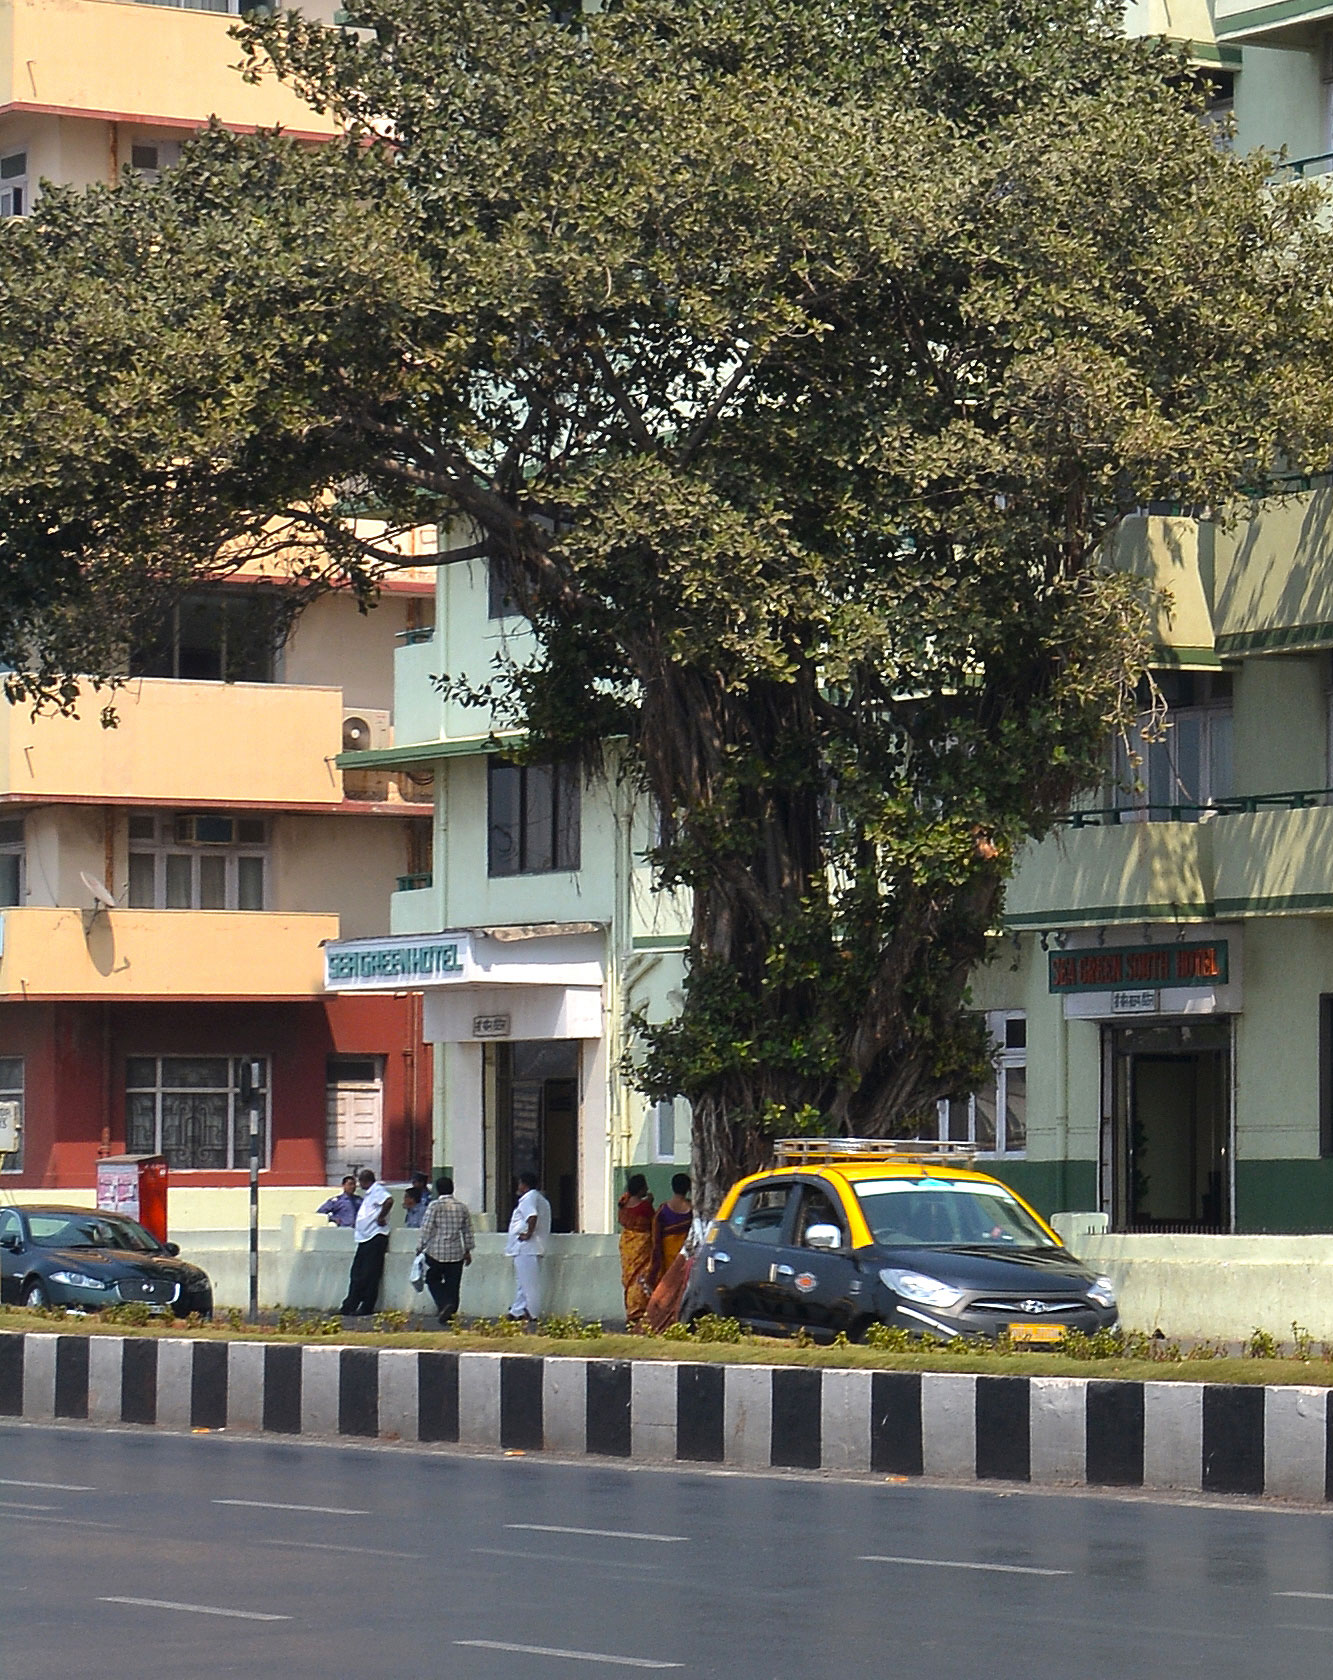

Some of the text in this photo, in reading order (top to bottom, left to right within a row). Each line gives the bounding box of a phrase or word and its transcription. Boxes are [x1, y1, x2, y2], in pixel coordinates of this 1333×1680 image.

[328, 944, 463, 979] SEA GREEN HOTEL
[1053, 947, 1220, 985] SEA GREEN SOUTH HOTEL
